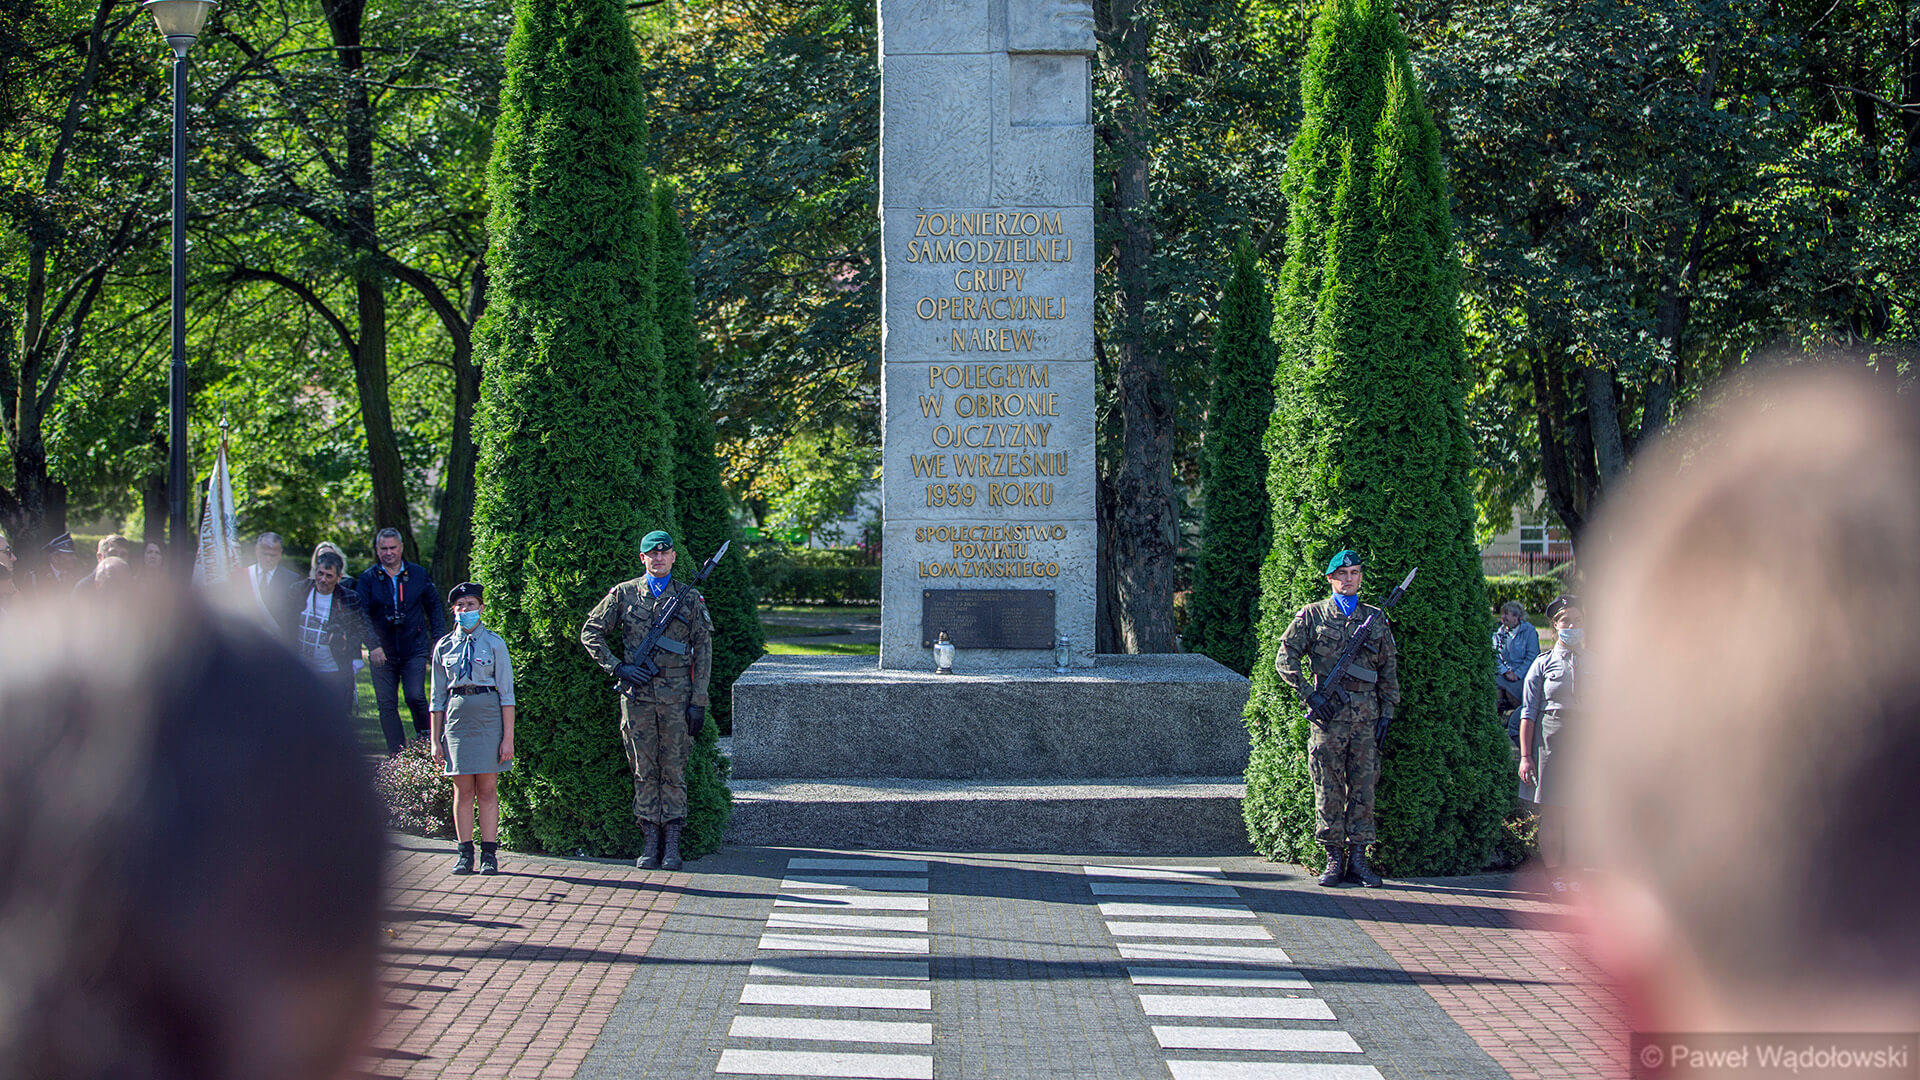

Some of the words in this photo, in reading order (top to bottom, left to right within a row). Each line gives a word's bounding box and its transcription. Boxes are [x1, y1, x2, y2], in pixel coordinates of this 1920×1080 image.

[915, 207, 1063, 237] ŻOŁNIERZOM
[906, 239, 1072, 263] SAMODZIELNEJ
[955, 268, 1026, 292] GRUPY
[916, 296, 1066, 320] OPERACYJNEJ
[929, 365, 1050, 389] POLEGŁYM
[920, 394, 944, 417] W
[955, 393, 1059, 417] OBRONIE
[932, 423, 1052, 448] OJCZYZNY
[911, 454, 947, 478] WE
[953, 449, 1068, 477] WRZEŚNIU
[926, 483, 976, 507] 1939
[989, 482, 1053, 506] ROKU
[953, 543, 1029, 559] POWIATU
